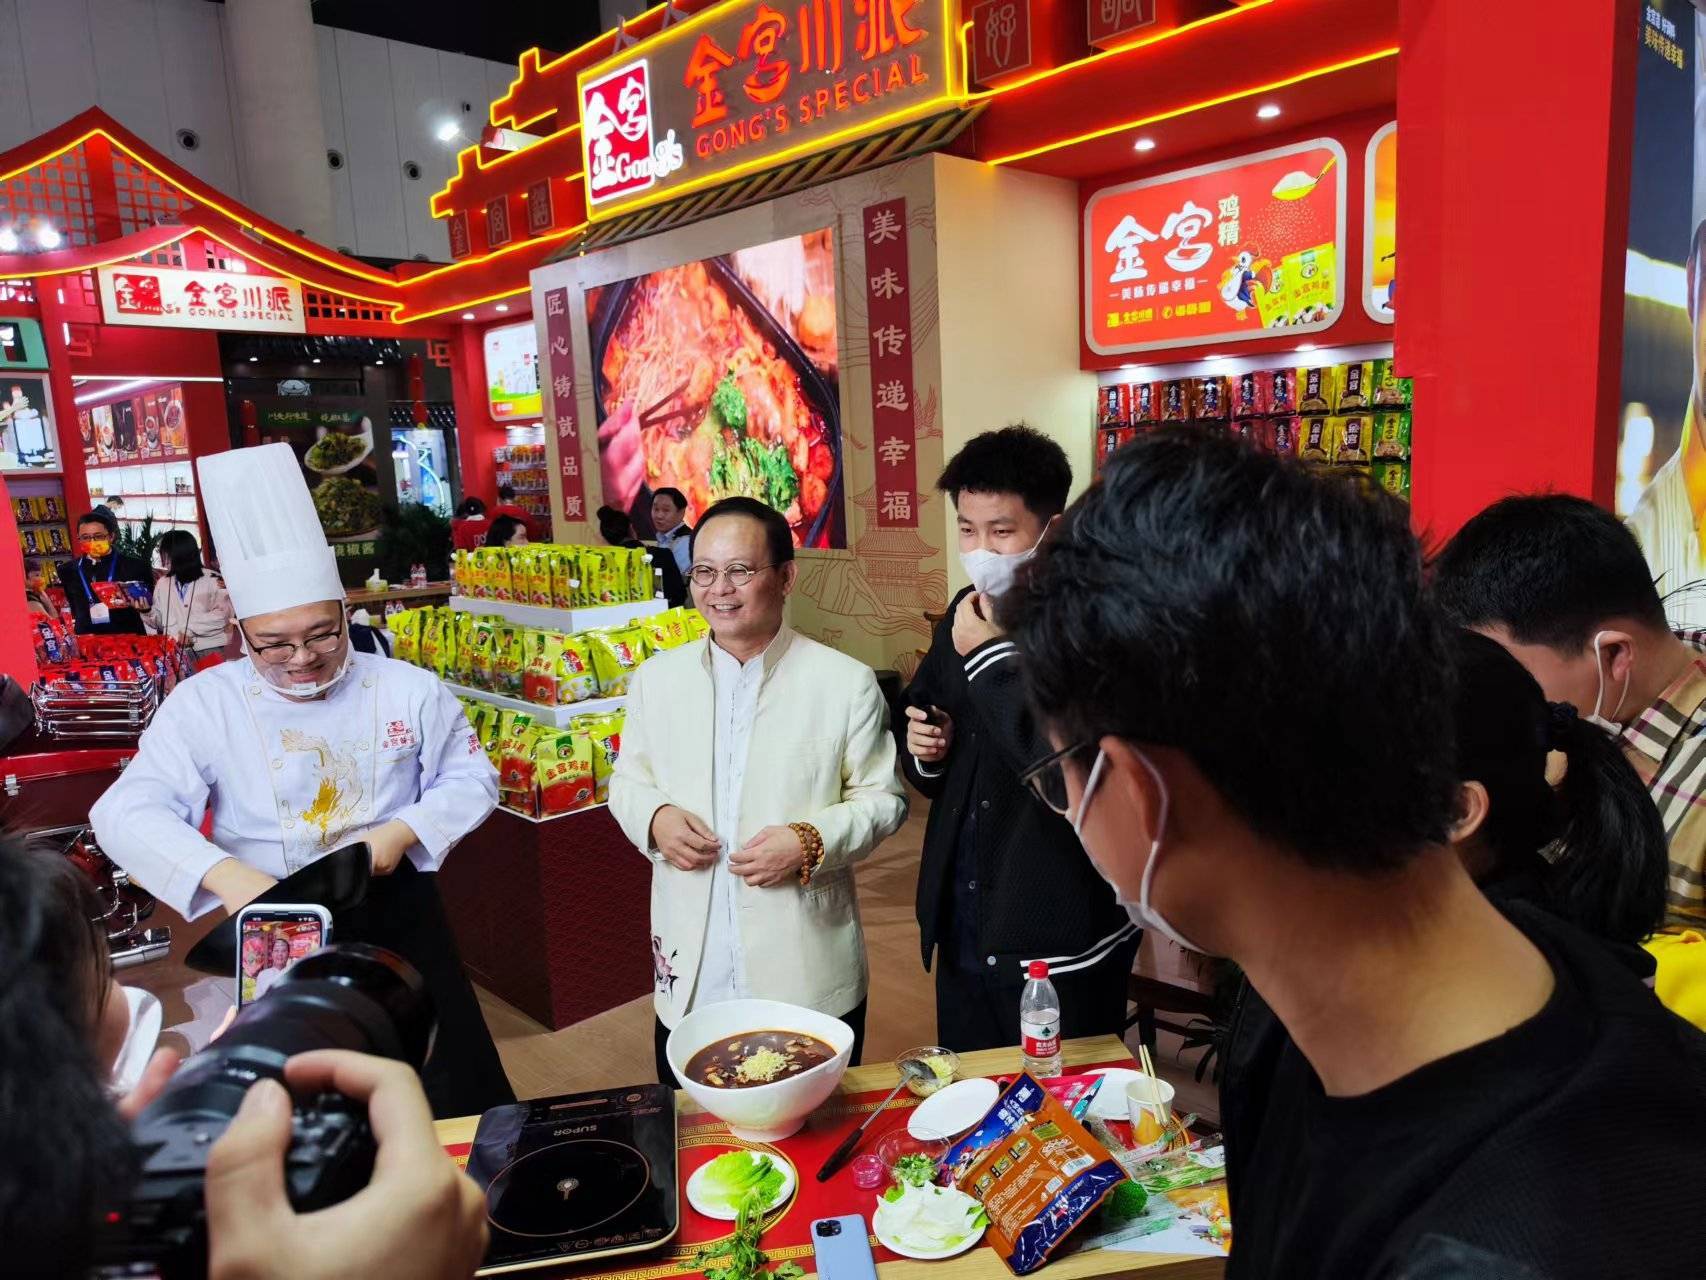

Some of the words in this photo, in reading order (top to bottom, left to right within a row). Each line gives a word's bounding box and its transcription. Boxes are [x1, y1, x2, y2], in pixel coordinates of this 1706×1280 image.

[685, 0, 929, 129] 金宫川派
[695, 104, 790, 159] GONG'S
[800, 54, 929, 124] SPECIAL
[616, 129, 683, 184] Gong's
[1105, 200, 1213, 283] 金宫
[1218, 193, 1240, 247] 鸡精
[184, 281, 293, 312] 金宫川派
[189, 308, 237, 318] GONG'S
[242, 311, 293, 321] SPECIAL
[868, 211, 911, 521] 美味传递幸福
[547, 293, 583, 517] 匠心铸就品质
[553, 1124, 598, 1137] SUPOR
